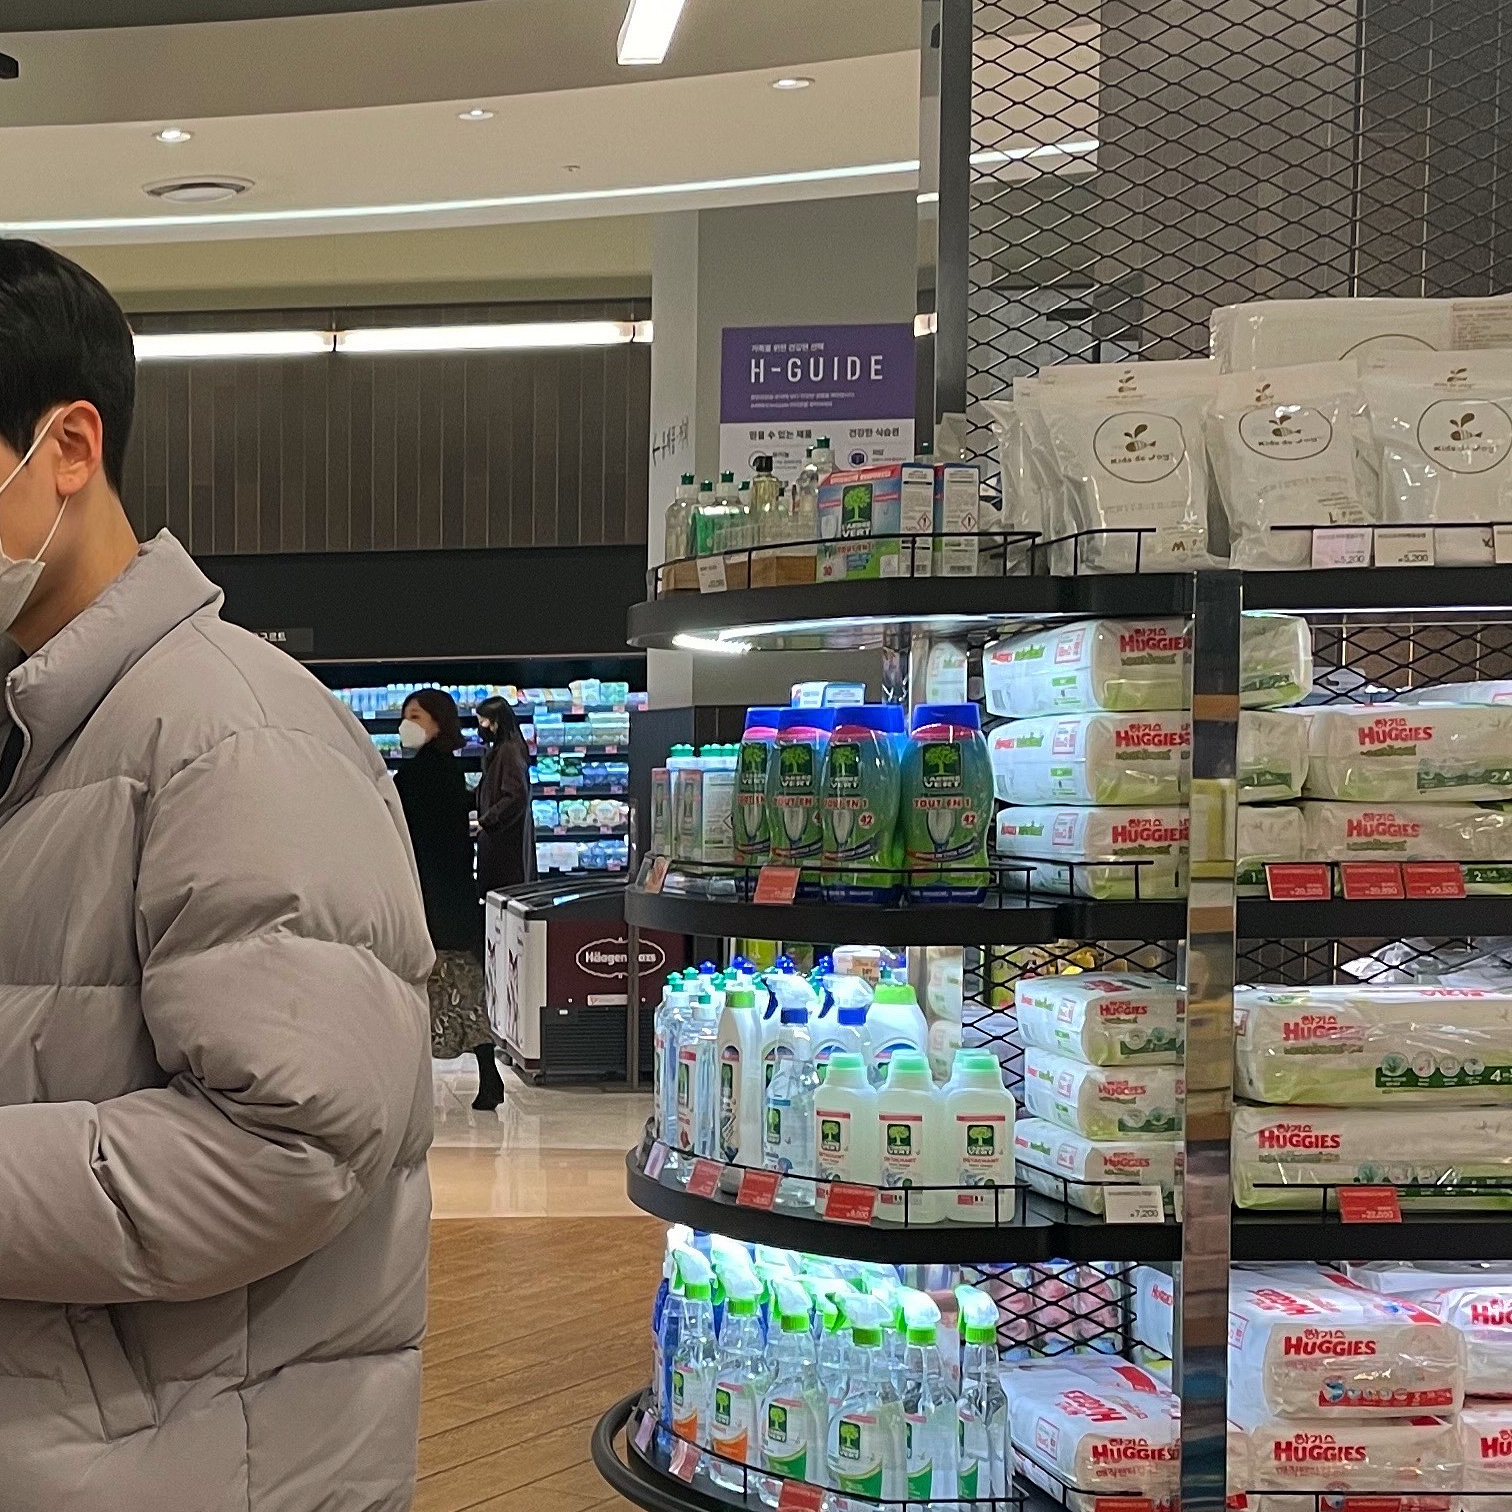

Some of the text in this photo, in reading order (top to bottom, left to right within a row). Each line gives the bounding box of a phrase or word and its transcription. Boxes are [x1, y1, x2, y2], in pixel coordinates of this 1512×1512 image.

[750, 354, 884, 384] H-GUIDE
[1358, 726, 1433, 746] HUGGIES
[1346, 818, 1420, 838] HUGGIES
[1257, 1128, 1341, 1150] HUGGIES
[1304, 1328, 1346, 1340] 하기스
[1284, 1335, 1377, 1357] HUGGIES
[1294, 1433, 1336, 1445] 하기스
[1273, 1440, 1367, 1463] HUGGIES
